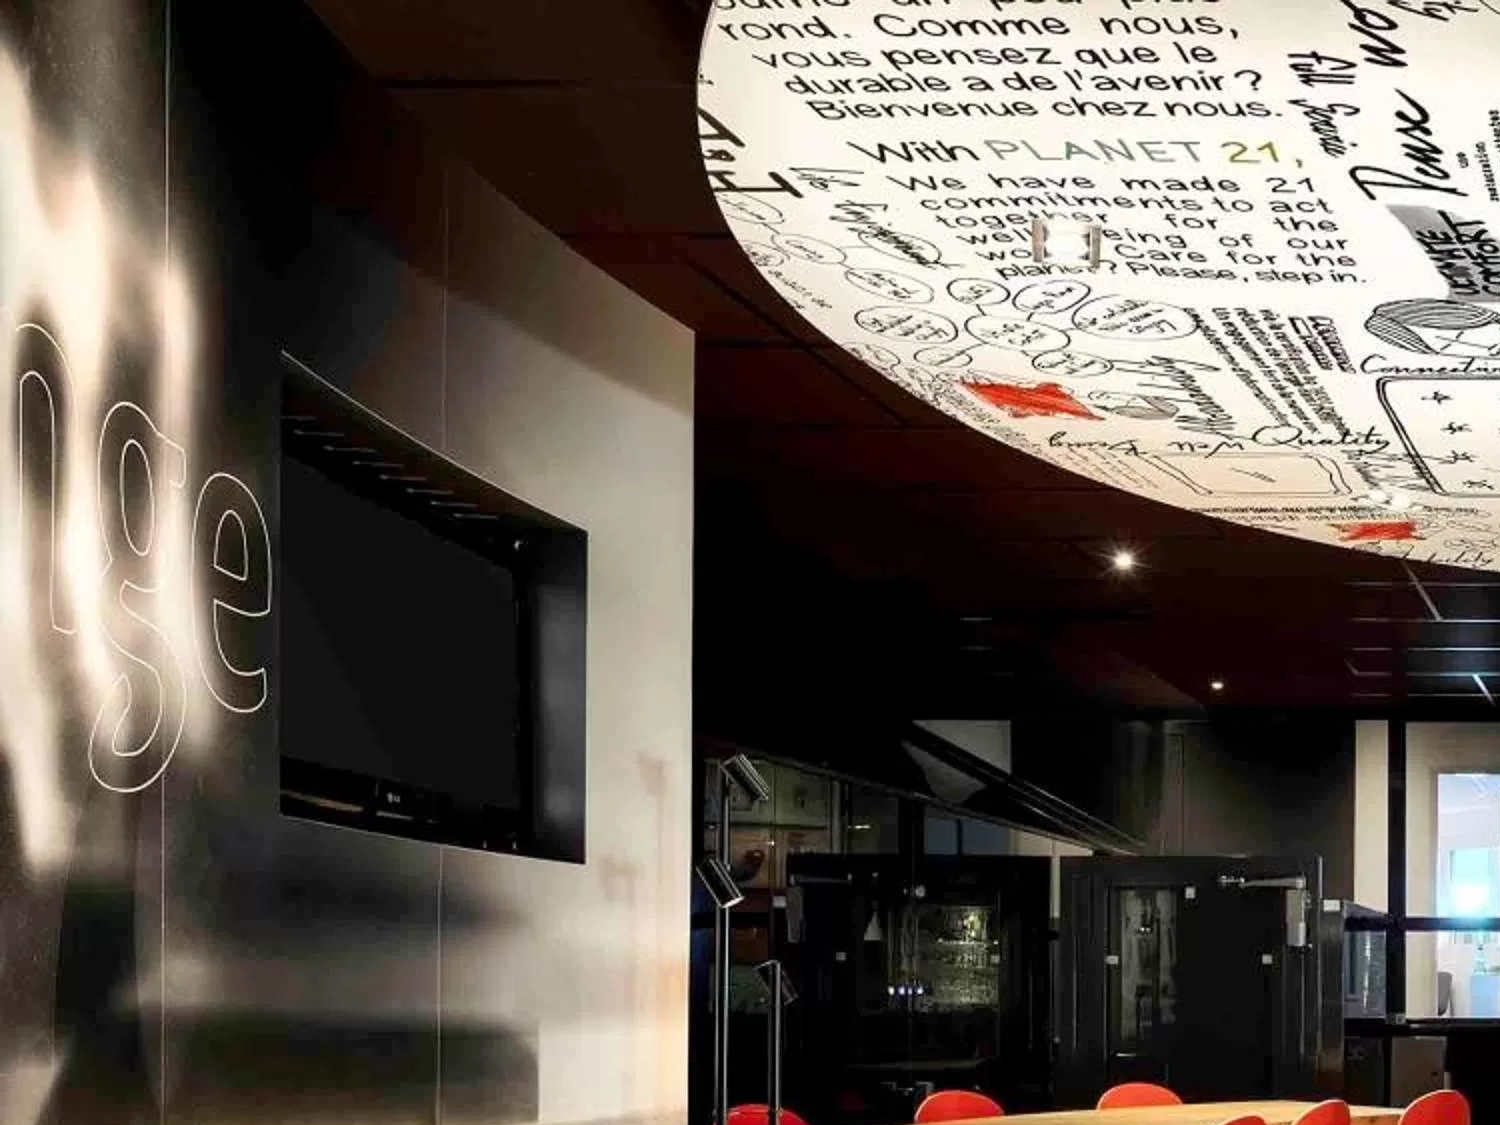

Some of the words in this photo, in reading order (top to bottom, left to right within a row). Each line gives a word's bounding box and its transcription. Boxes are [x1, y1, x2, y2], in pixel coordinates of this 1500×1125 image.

[718, 16, 852, 40] rond.
[873, 14, 1070, 37] Comme
[1099, 16, 1238, 39] nous,
[752, 49, 871, 69] vous
[881, 47, 1062, 70] pensez
[1074, 46, 1160, 69] que
[1173, 42, 1218, 64] le
[784, 74, 951, 95] durable
[963, 75, 994, 92] a
[1002, 72, 1058, 91] de
[1064, 70, 1224, 91] l'avenir
[1234, 70, 1263, 91] ?
[805, 98, 1039, 120] Bienvenue
[1051, 97, 1158, 116] chez
[1164, 100, 1283, 117] nous.
[846, 140, 981, 164] With
[982, 139, 1200, 163] PLANET
[886, 174, 967, 192] We
[989, 173, 1095, 191] have
[1120, 175, 1241, 193] made
[1264, 177, 1317, 193] 21
[920, 193, 1203, 212] commitments
[1210, 198, 1254, 214] to
[1269, 198, 1334, 214] act
[1164, 212, 1218, 231] for
[1274, 216, 1340, 233] the
[1219, 232, 1252, 248] of
[1287, 236, 1350, 251] our
[1115, 243, 1207, 263] Care
[1224, 250, 1280, 266] for
[1297, 252, 1357, 267] the
[1128, 262, 1250, 284] Please,
[1254, 268, 1324, 286] step
[1328, 269, 1368, 284] in.
[1252, 424, 1390, 455] Quality
